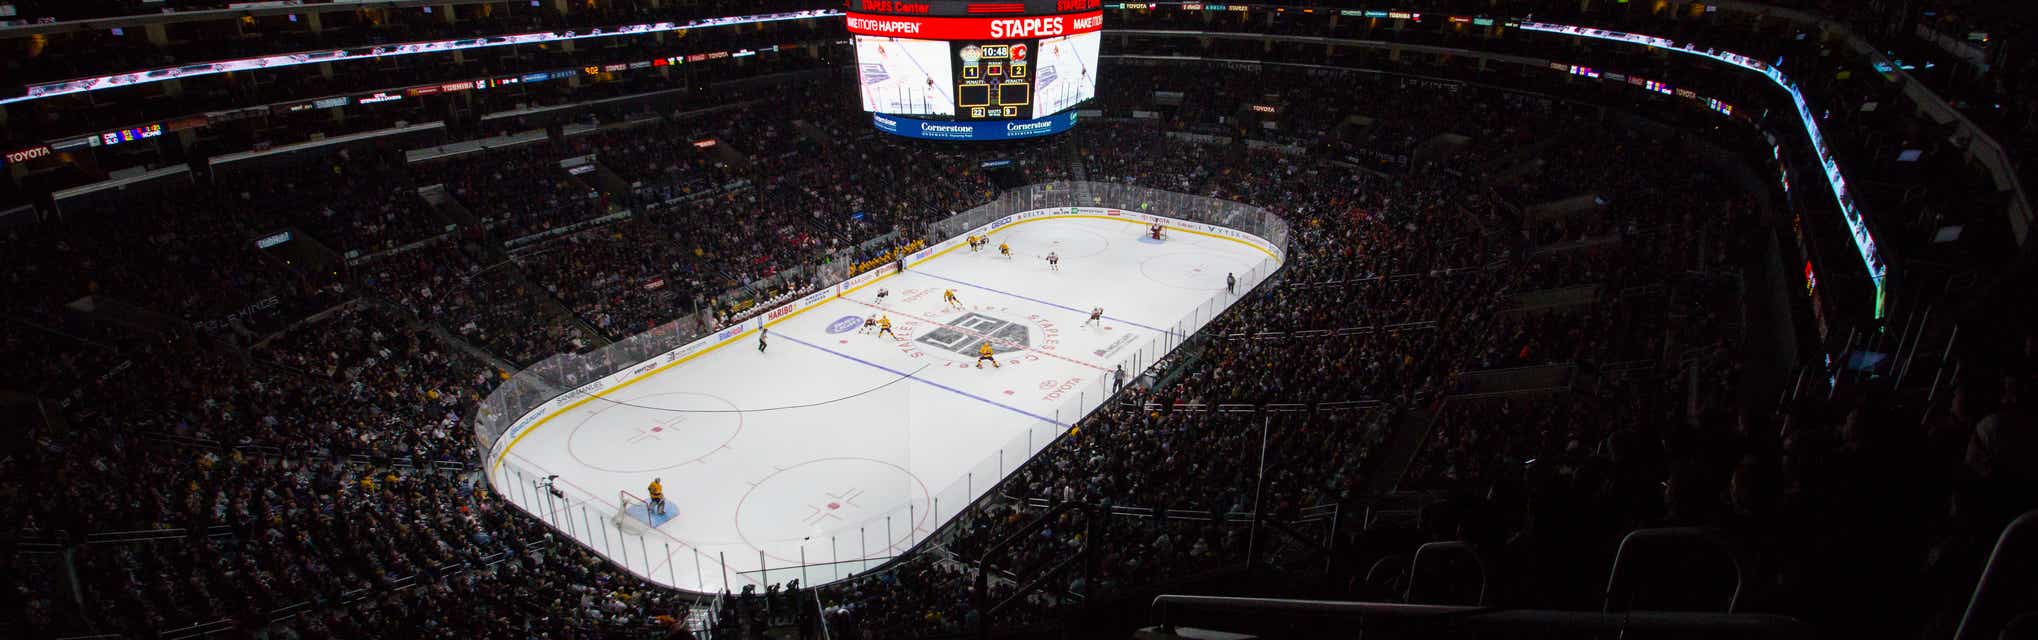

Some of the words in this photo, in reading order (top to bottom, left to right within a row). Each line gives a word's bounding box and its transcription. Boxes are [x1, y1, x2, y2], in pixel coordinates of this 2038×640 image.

[990, 17, 1063, 38] STAPLES
[983, 47, 1007, 57] 10:48
[921, 122, 973, 132] Cornerstone
[1007, 120, 1052, 132] Cornerstone
[6, 146, 51, 163] TOYOTA
[767, 304, 794, 321] HARIBO
[1041, 377, 1083, 401] TOYOTA
